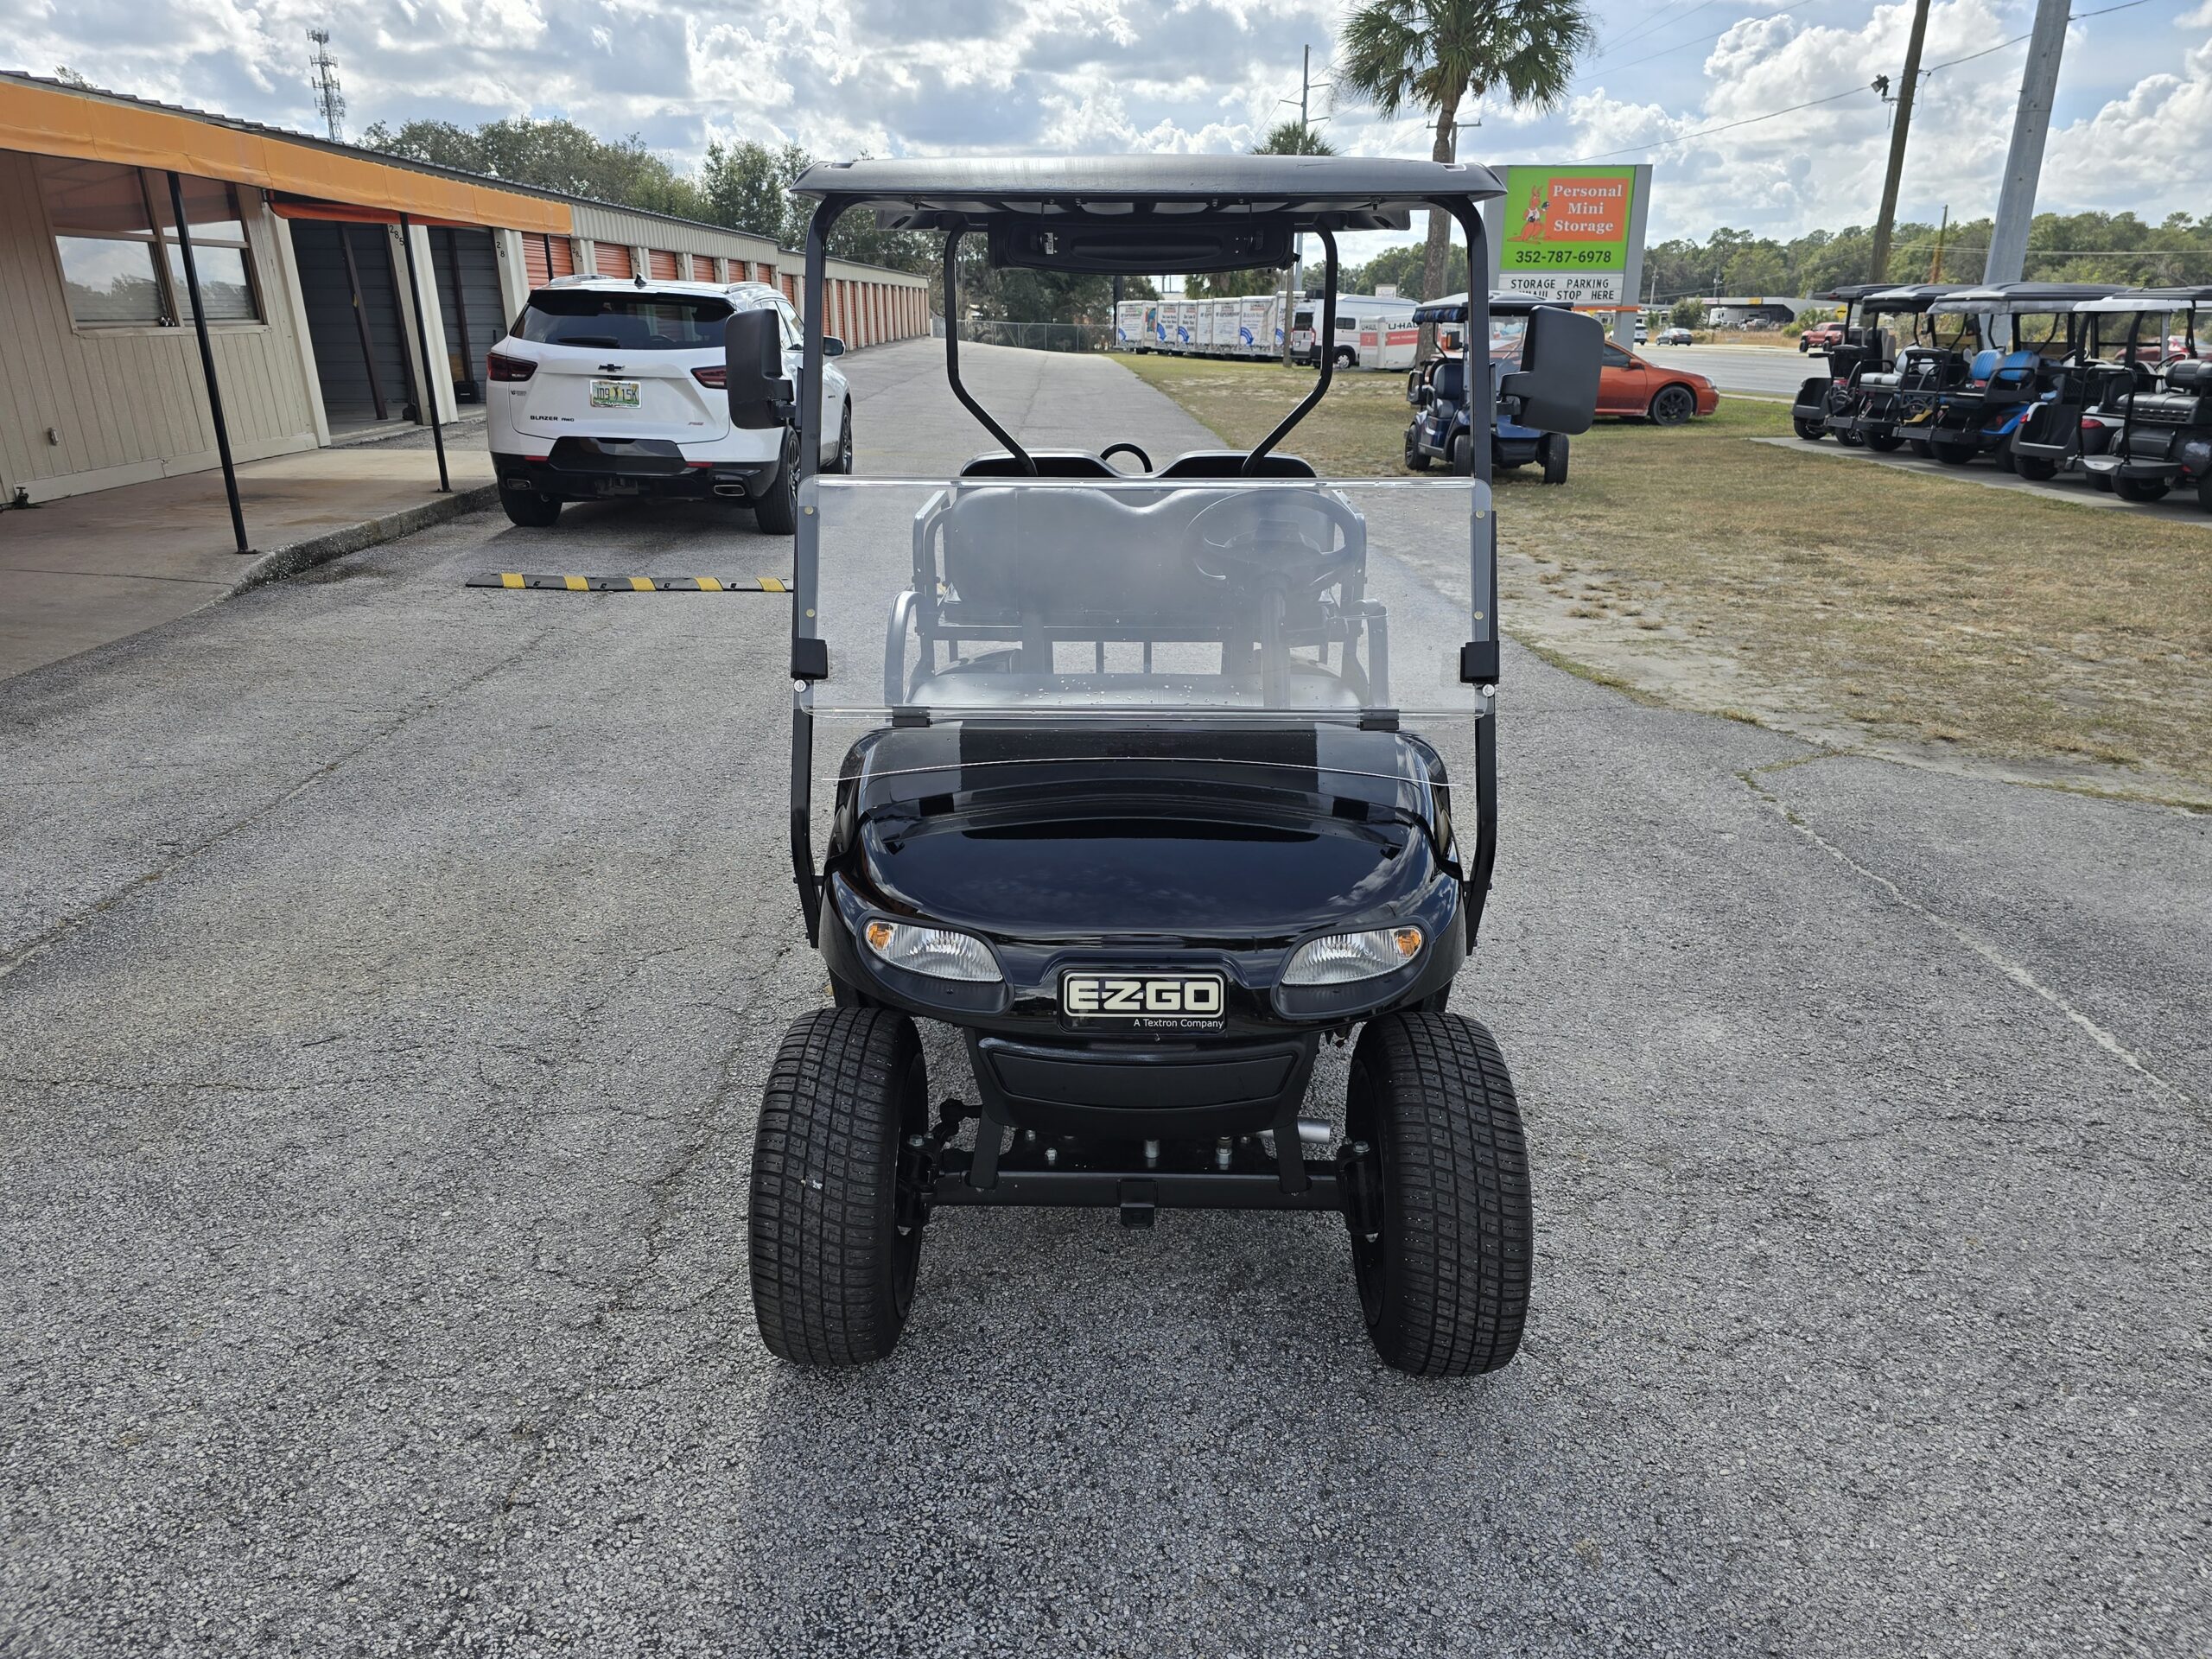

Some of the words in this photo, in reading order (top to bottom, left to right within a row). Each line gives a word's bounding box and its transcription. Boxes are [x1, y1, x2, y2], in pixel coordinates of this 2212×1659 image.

[1553, 185, 1622, 197] Personal
[1567, 202, 1604, 214] Mini
[1554, 219, 1613, 234] Storage
[1516, 251, 1611, 263] 352-787-6978
[1511, 279, 1555, 289] STORAGE
[1567, 279, 1609, 289] PARKING
[1557, 290, 1582, 300] STOP
[1592, 290, 1614, 300] HERE
[1143, 1019, 1178, 1027] Textron
[1180, 1019, 1224, 1029] Company
